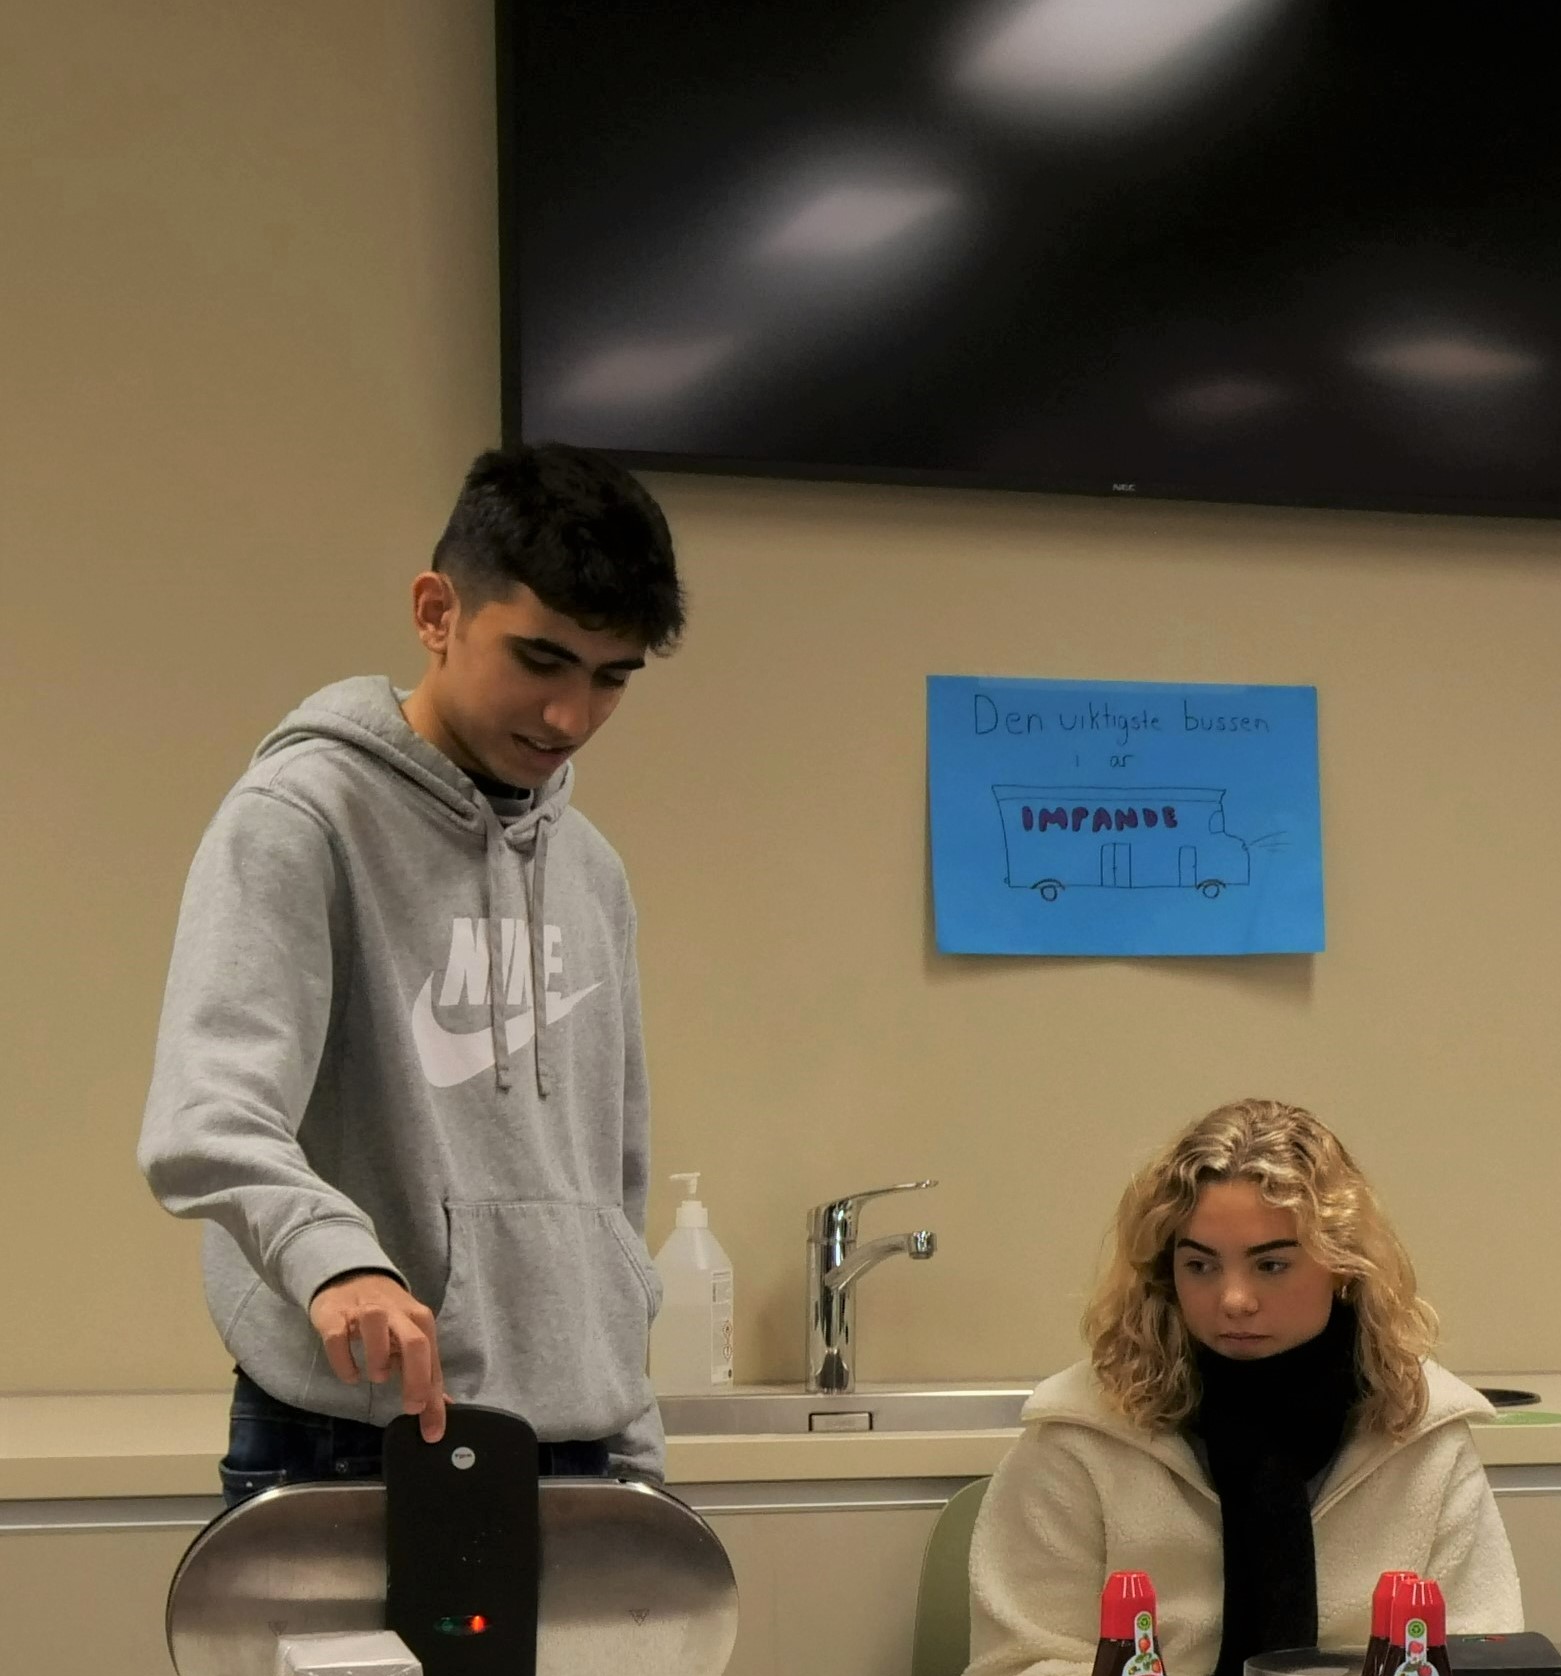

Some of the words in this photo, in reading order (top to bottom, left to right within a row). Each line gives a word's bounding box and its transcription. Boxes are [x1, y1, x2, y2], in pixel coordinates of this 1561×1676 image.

[1112, 483, 1136, 492] NEC
[974, 694, 1043, 735] Den
[1183, 699, 1270, 733] bussen
[1022, 806, 1178, 832] IMPANDE
